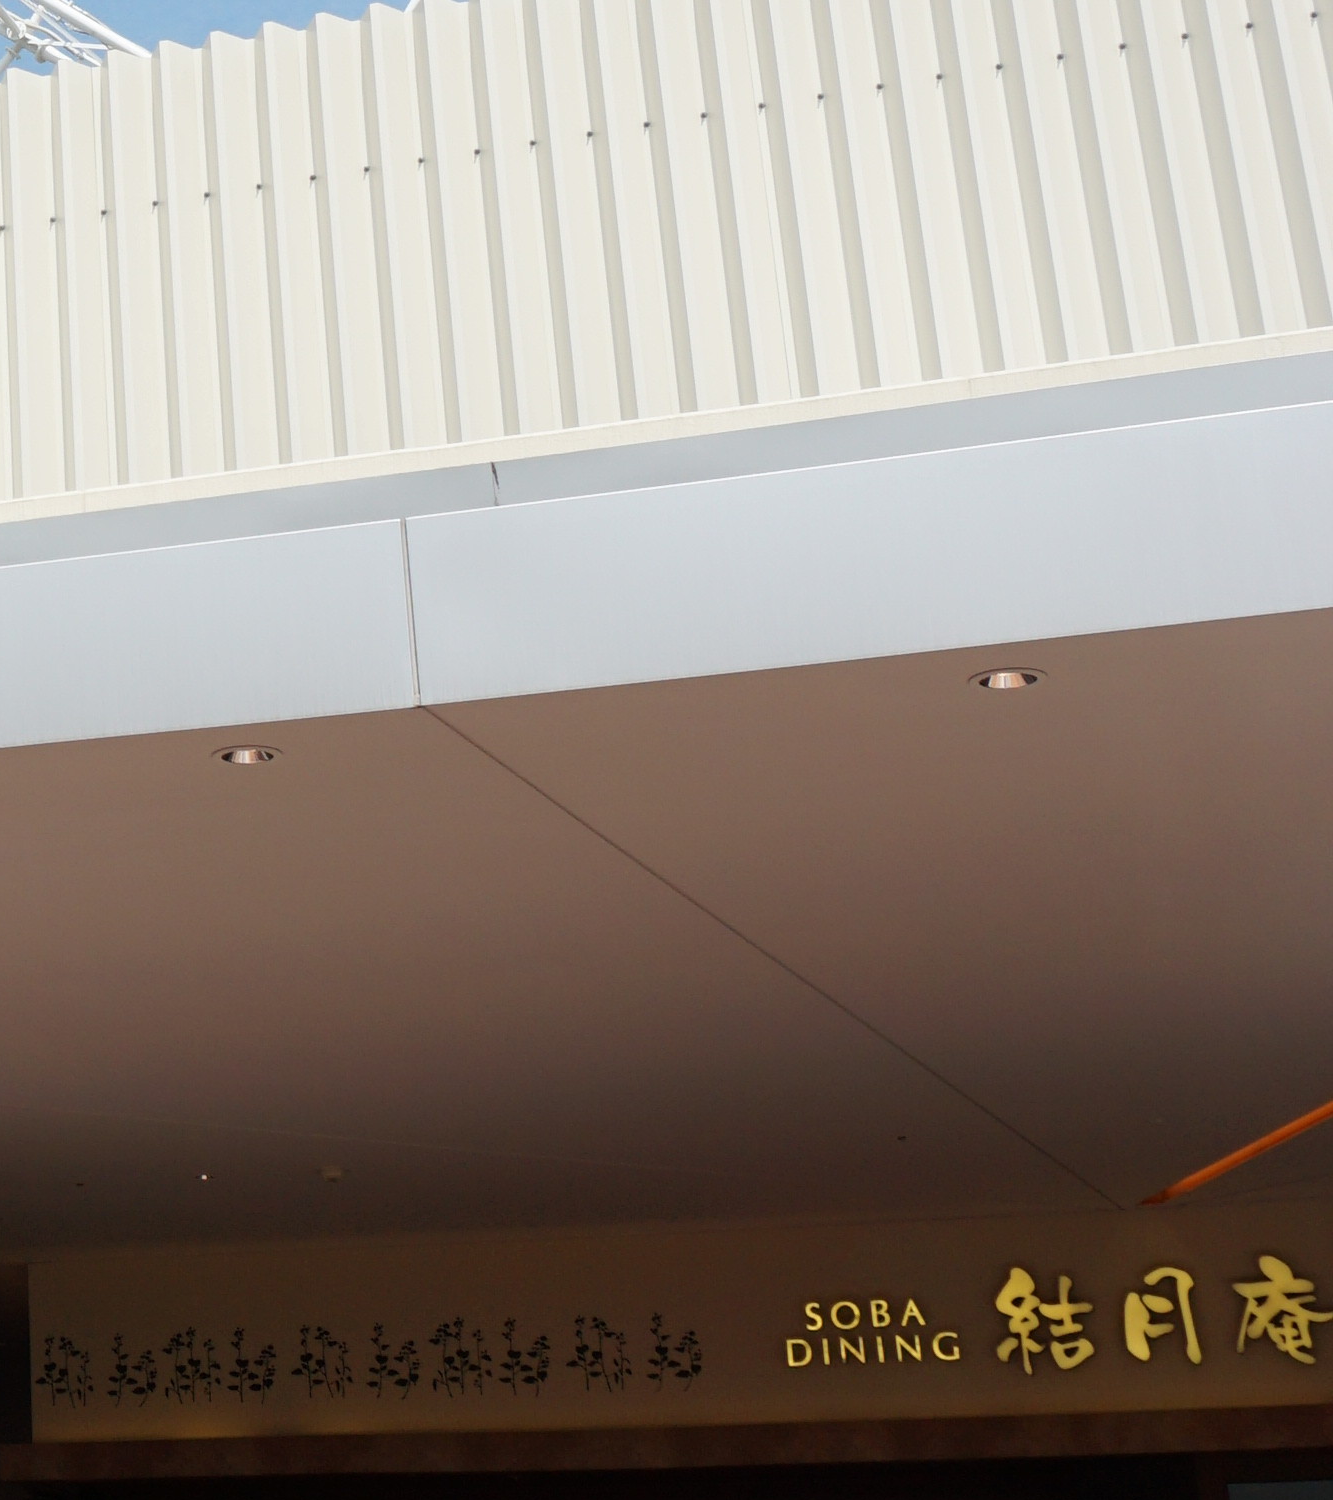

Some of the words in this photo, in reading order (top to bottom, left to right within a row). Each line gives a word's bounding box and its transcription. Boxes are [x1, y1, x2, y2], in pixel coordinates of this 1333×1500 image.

[803, 1297, 928, 1333] SOBA
[994, 1254, 1333, 1376] 結月庵
[784, 1330, 962, 1369] DINING
